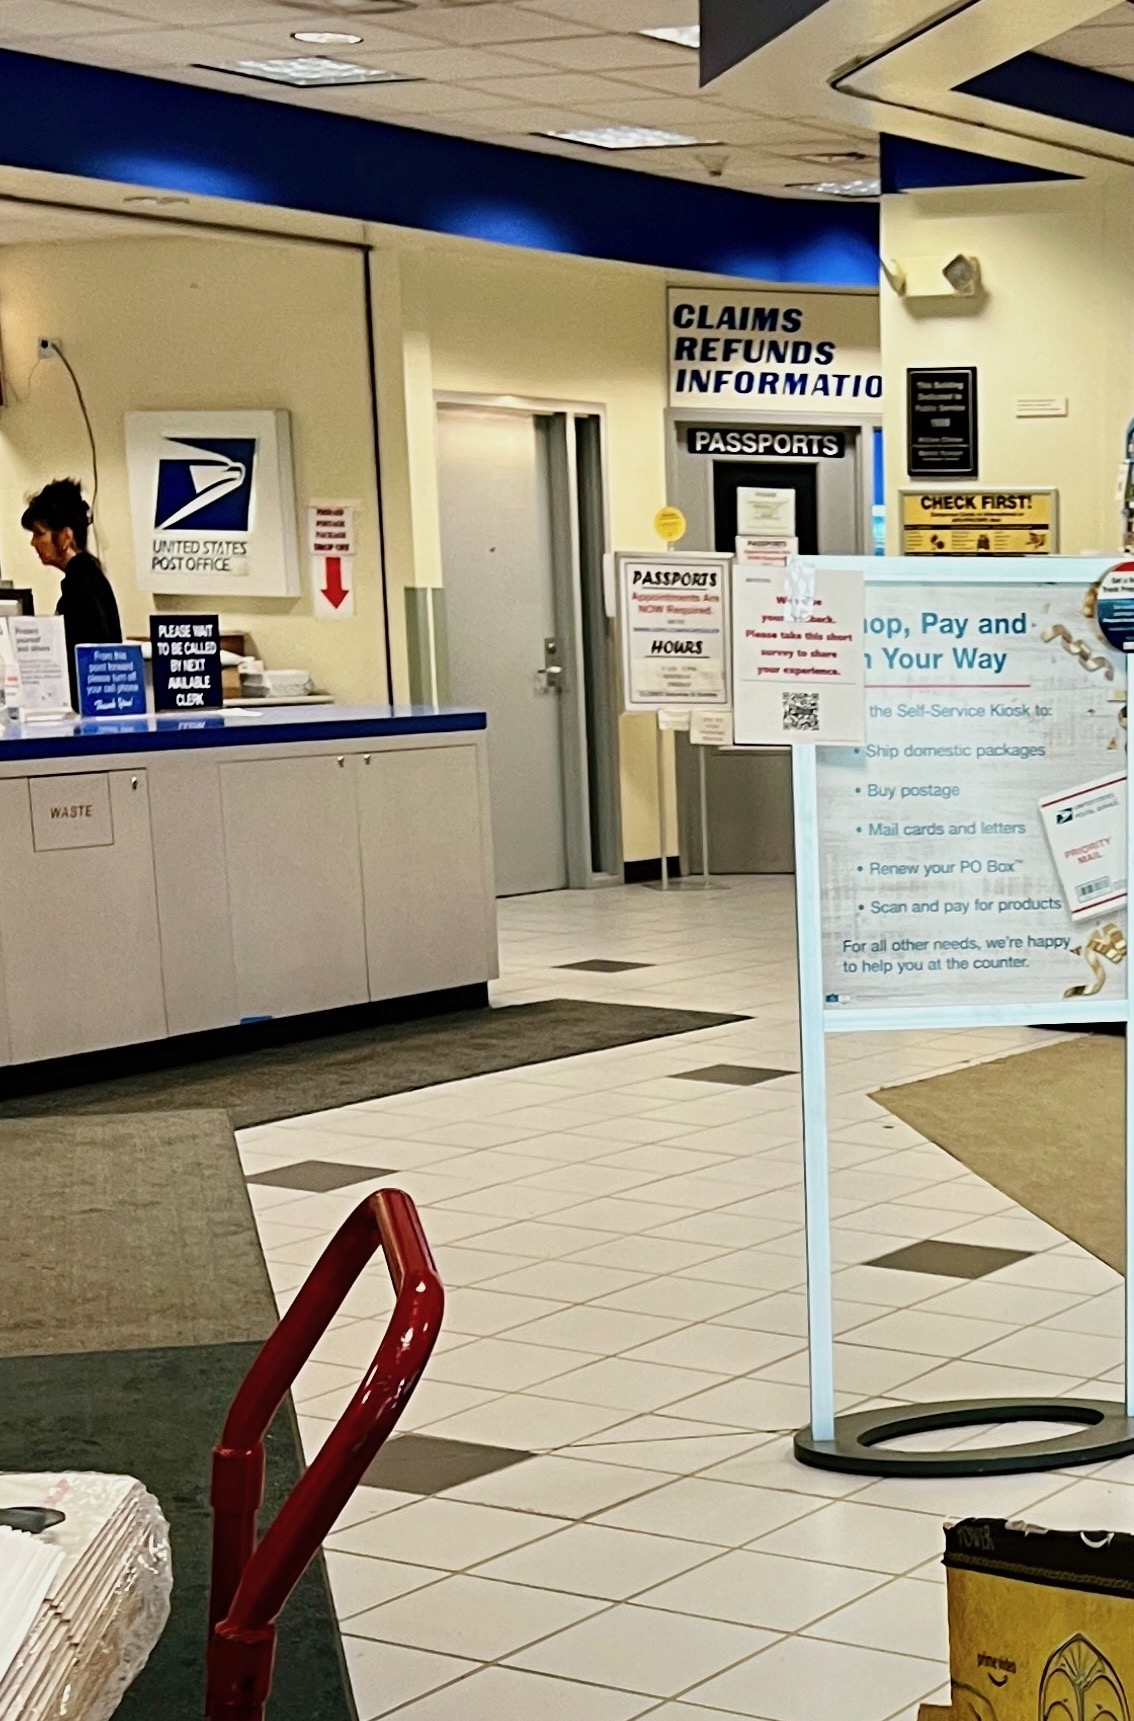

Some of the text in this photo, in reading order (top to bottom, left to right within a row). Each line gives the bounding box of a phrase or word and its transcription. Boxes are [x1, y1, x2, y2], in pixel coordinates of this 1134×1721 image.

[673, 304, 803, 333] CLAIMS
[674, 336, 836, 365] REFUNDS
[676, 369, 883, 398] INFORMATIO
[695, 431, 839, 456] PASSPORTS
[921, 494, 1032, 510] CHECK FIRST!
[153, 540, 247, 555] UNITED STATES
[152, 557, 230, 572] POST OFFICE
[633, 571, 717, 587] PASSPORTS
[158, 624, 213, 638] PLEASE WAIT
[921, 612, 968, 639] Pay
[978, 612, 1027, 634] and
[157, 641, 217, 655] TO BE CALLED
[651, 640, 703, 655] HOURS
[798, 650, 807, 658] to
[170, 659, 205, 672] BY NEXT
[882, 647, 1007, 674] Your Way
[176, 693, 204, 706] CLERK
[870, 704, 892, 717] the
[897, 704, 985, 718] Self-Service
[990, 704, 1030, 717] Kiosk
[866, 743, 1046, 760] Ship domestic packages
[867, 784, 960, 801] Buy postage
[50, 804, 93, 819] WASTE
[869, 821, 1026, 836] Mail cards and letters
[1064, 836, 1112, 859] PRIORITY
[870, 863, 919, 876] Renew
[923, 863, 955, 878] your
[960, 860, 982, 874] PO
[871, 898, 1062, 917] Scan and pay for products
[843, 936, 1071, 953] For all other needs, we're happy
[843, 957, 1030, 975] to help you at the counter.
